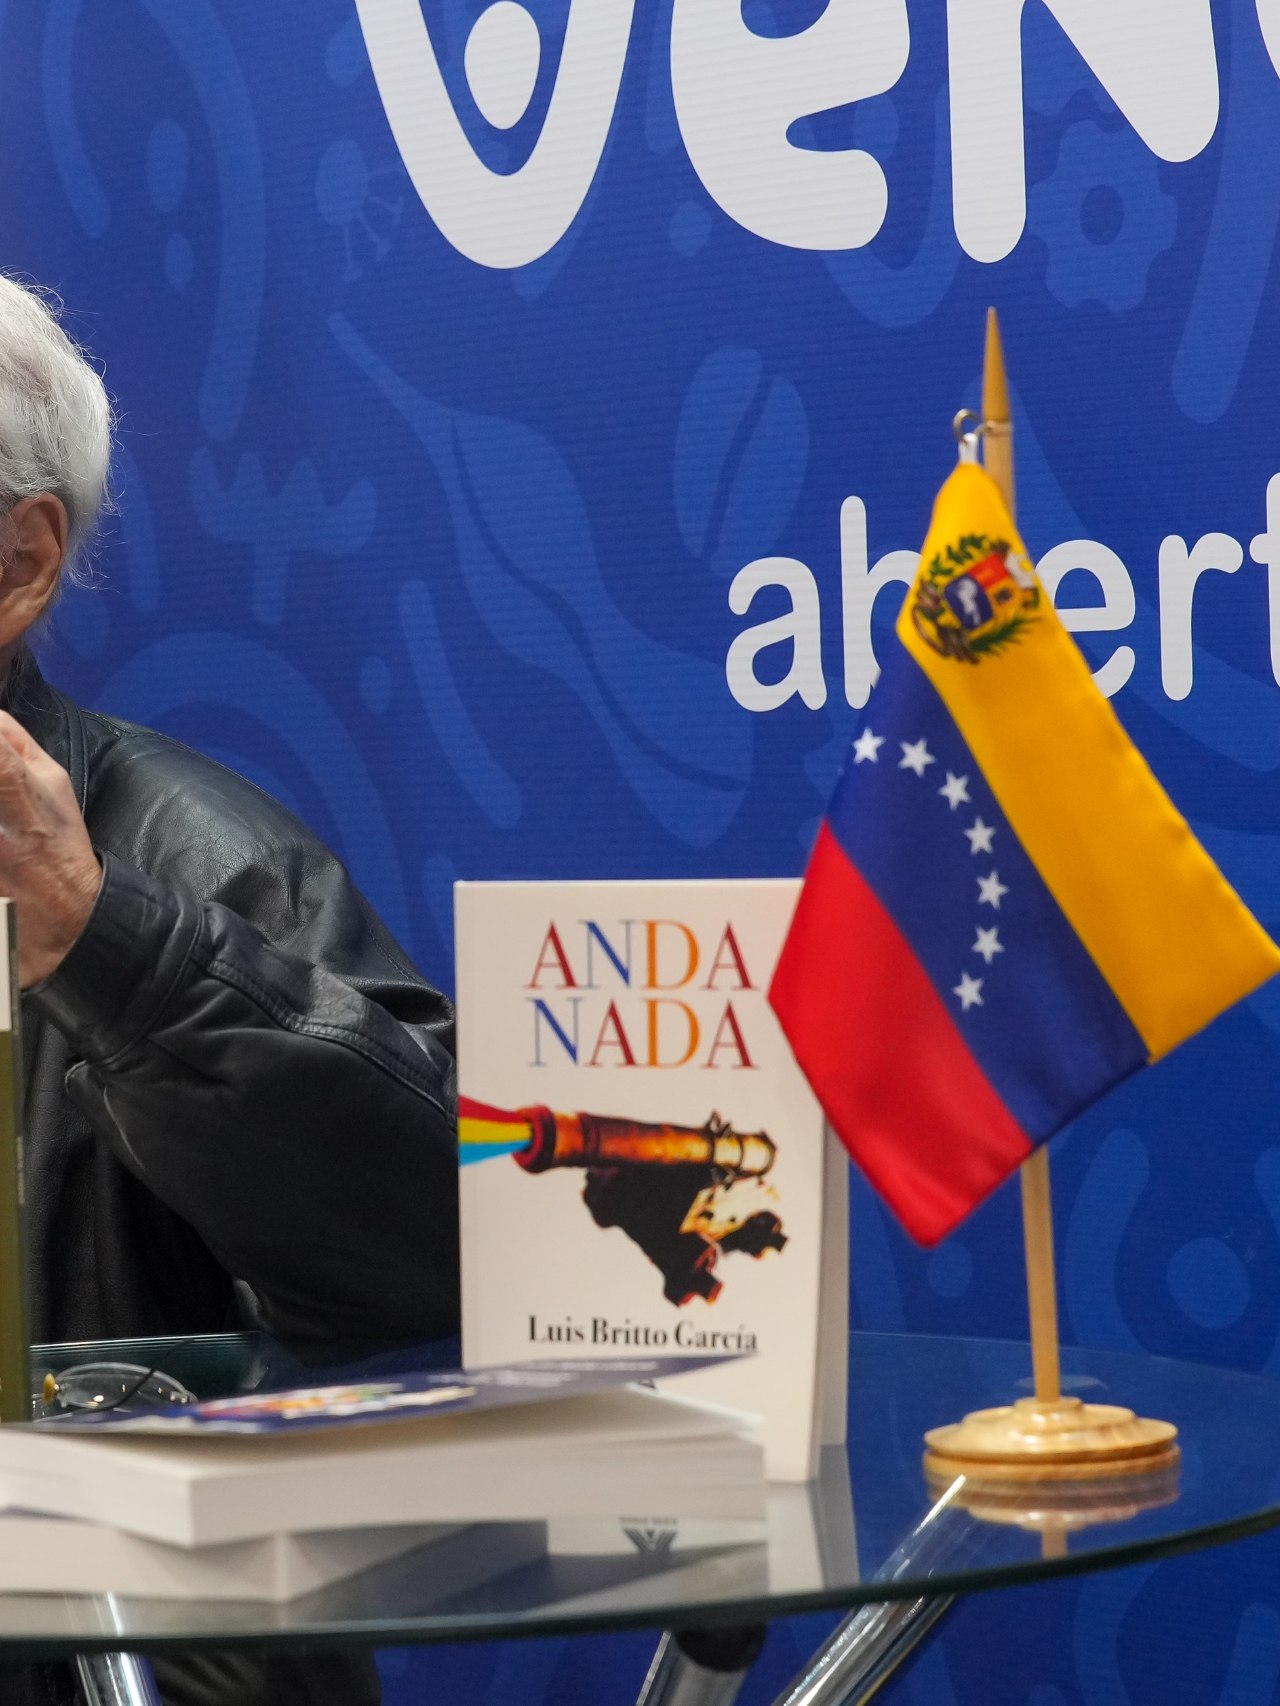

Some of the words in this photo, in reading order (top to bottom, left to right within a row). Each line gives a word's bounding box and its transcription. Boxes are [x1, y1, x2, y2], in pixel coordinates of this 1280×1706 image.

[523, 920, 760, 992] ANDA
[527, 997, 760, 1069] NADA
[528, 1315, 585, 1344] Luis
[591, 1316, 668, 1347] Britto
[675, 1321, 758, 1352] García
